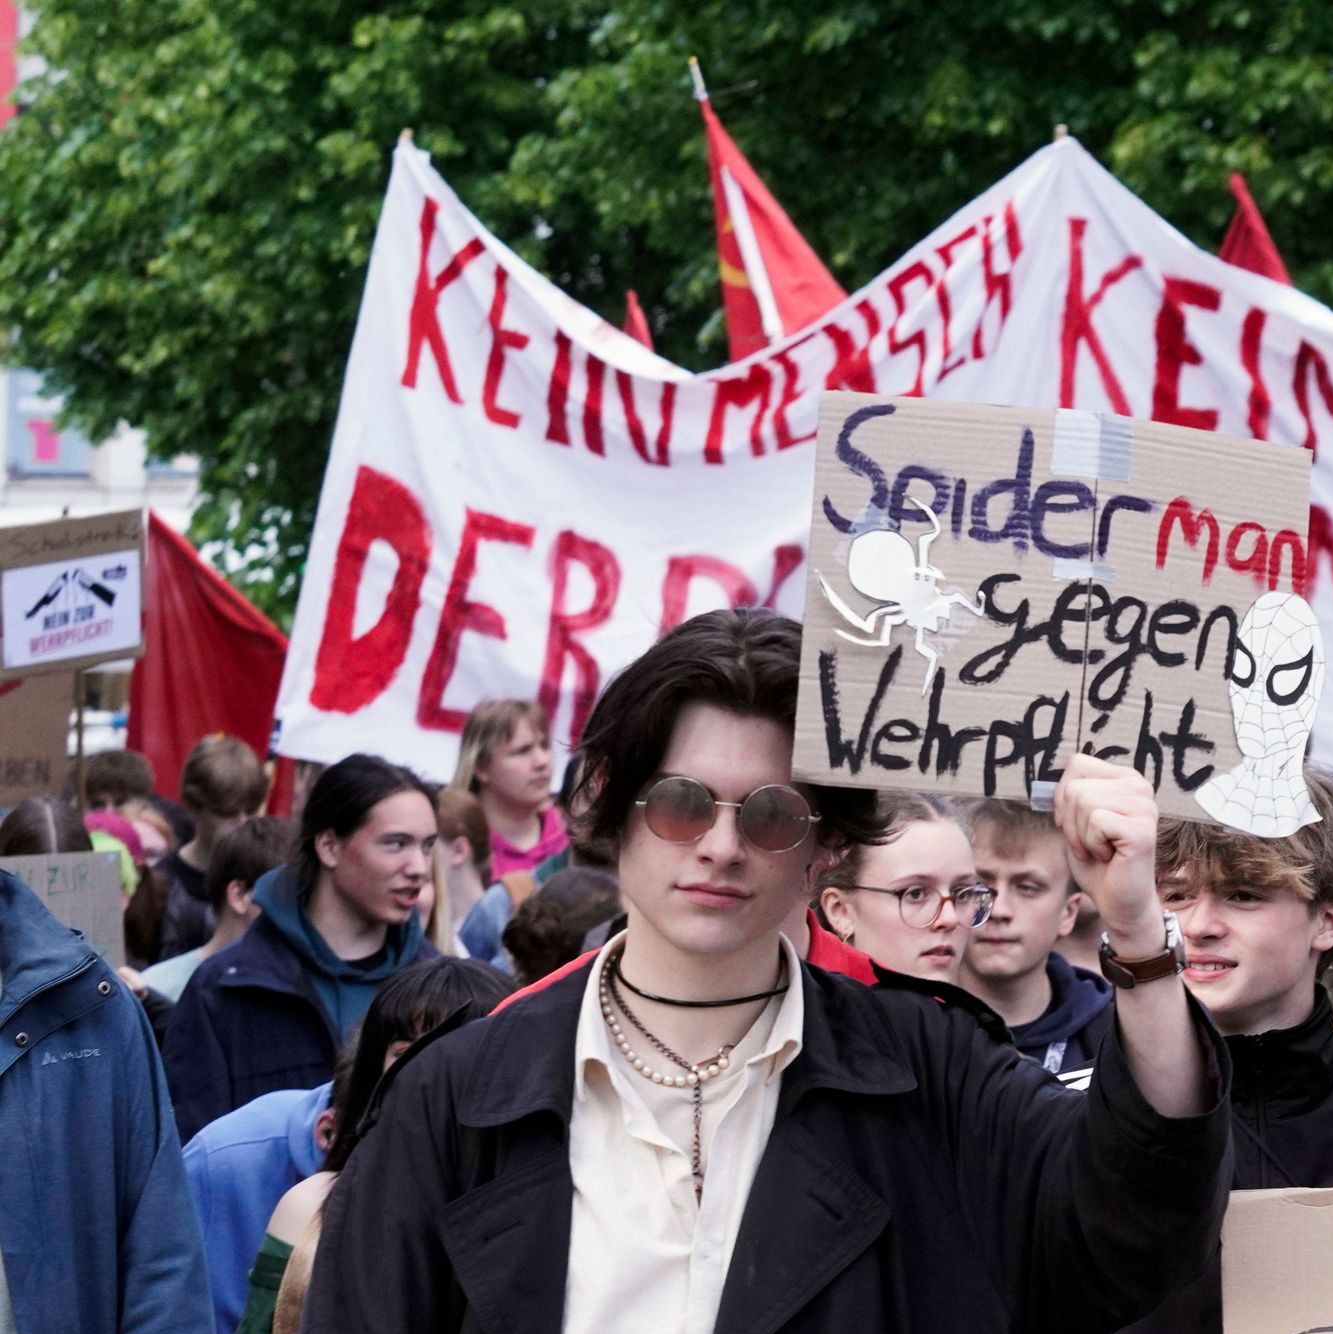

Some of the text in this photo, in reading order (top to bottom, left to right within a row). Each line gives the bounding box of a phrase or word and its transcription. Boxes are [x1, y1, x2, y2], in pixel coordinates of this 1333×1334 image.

[401, 197, 678, 467] KEIN
[704, 194, 1023, 465] MENSCH
[309, 465, 621, 753] DER
[957, 571, 1240, 711] gegen
